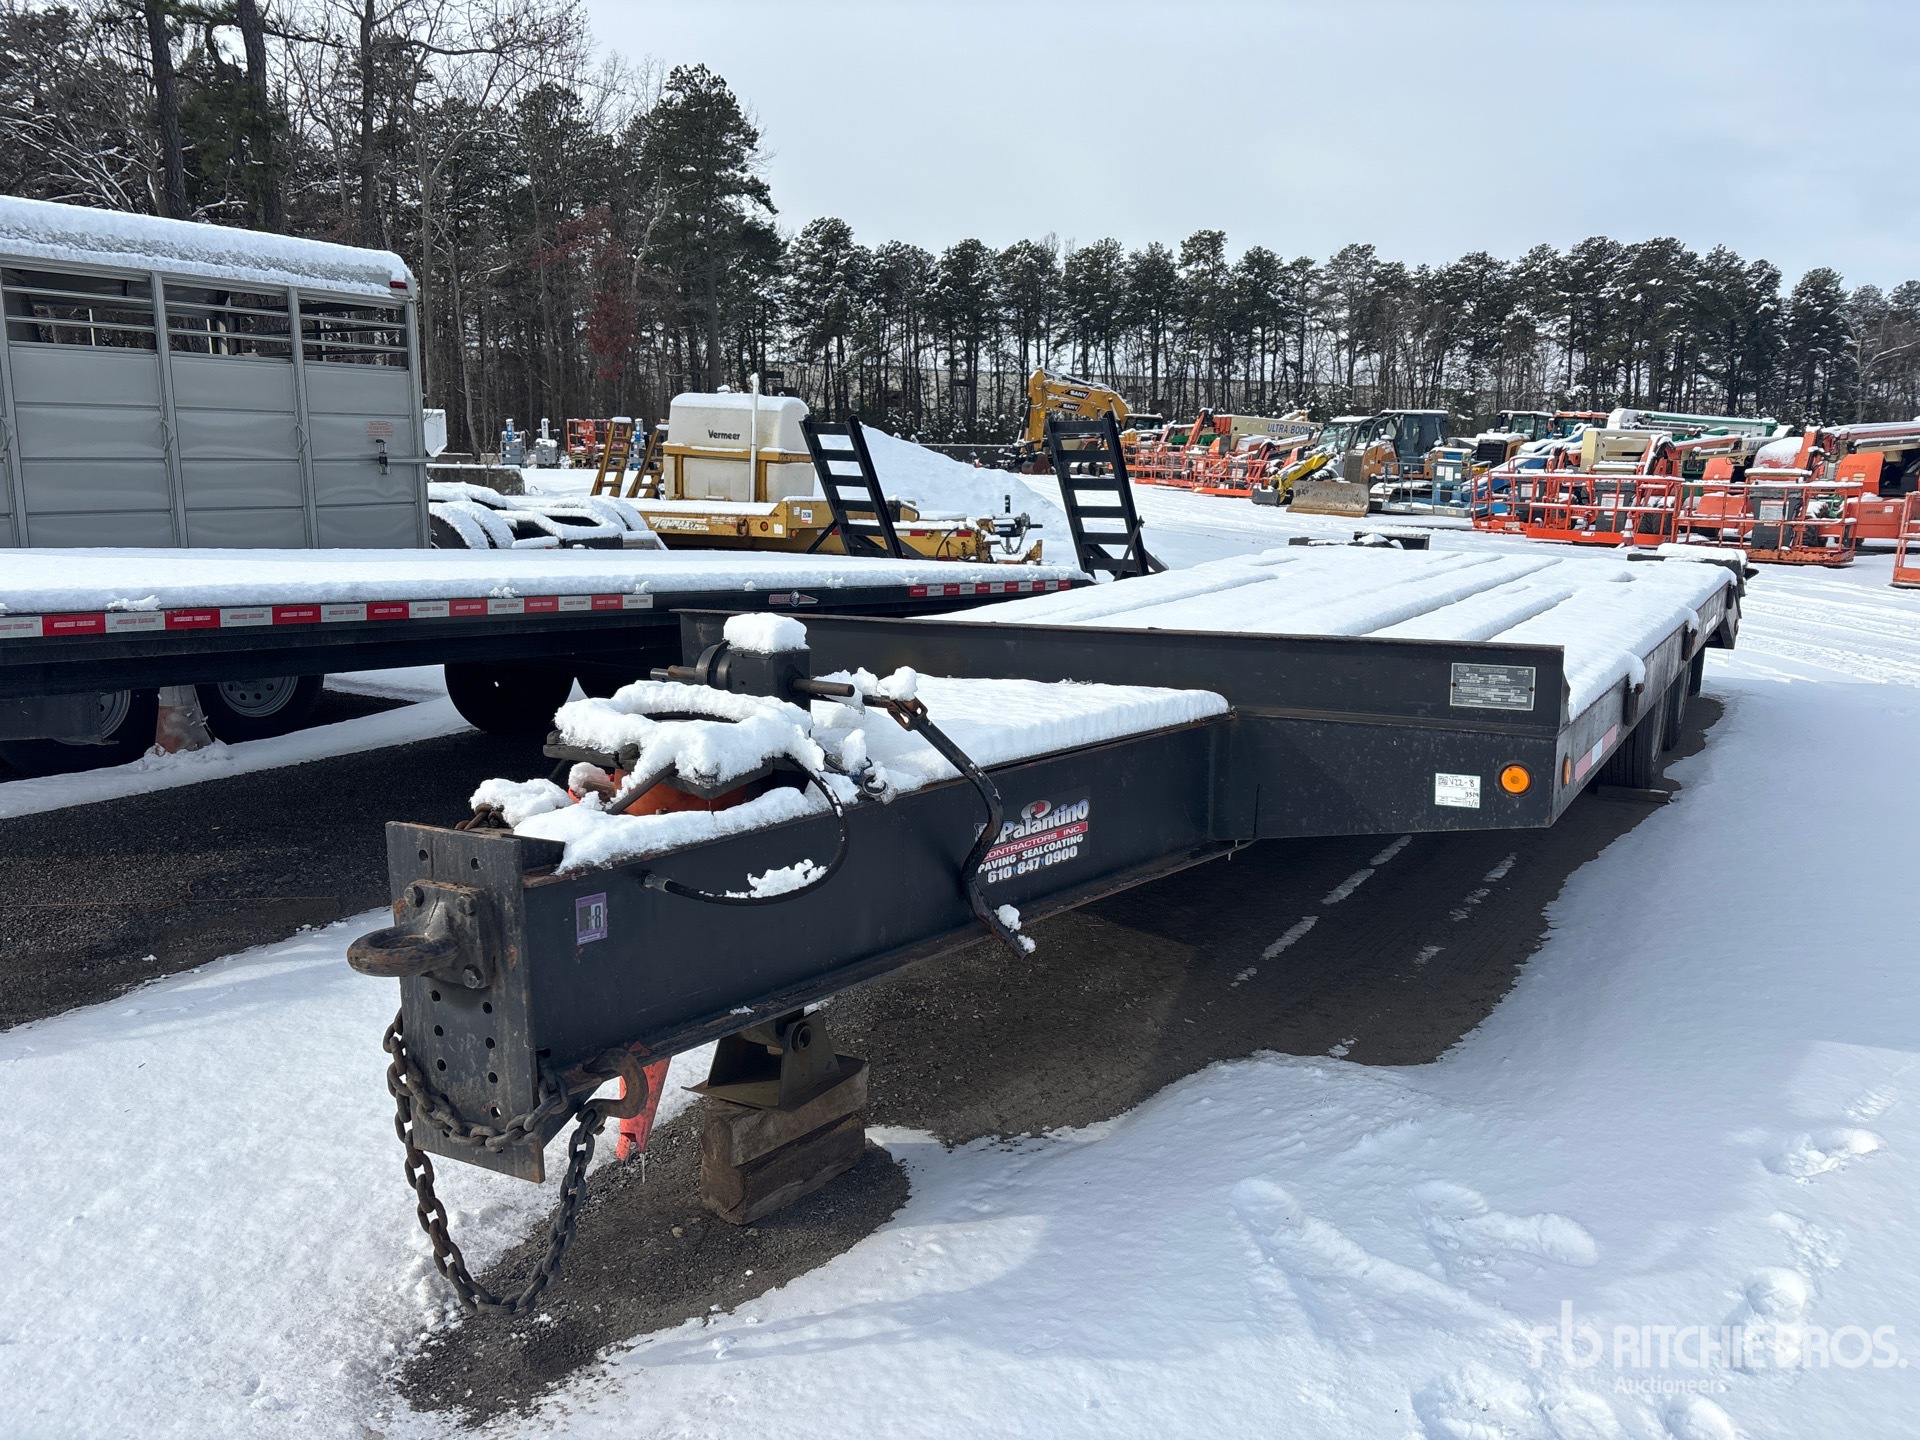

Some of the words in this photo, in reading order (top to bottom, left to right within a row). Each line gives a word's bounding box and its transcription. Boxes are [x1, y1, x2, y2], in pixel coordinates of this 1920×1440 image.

[1070, 390, 1087, 398] SANY
[1267, 423, 1288, 433] ULTRA
[707, 429, 740, 440] Vermeer
[999, 798, 1089, 843] Palantino
[1063, 826, 1083, 836] INC.
[978, 854, 1017, 874] PAVING
[1022, 834, 1084, 859] SEALCOATING
[987, 866, 1012, 884] 610
[1017, 857, 1041, 875] 847
[1045, 845, 1078, 866] 0900
